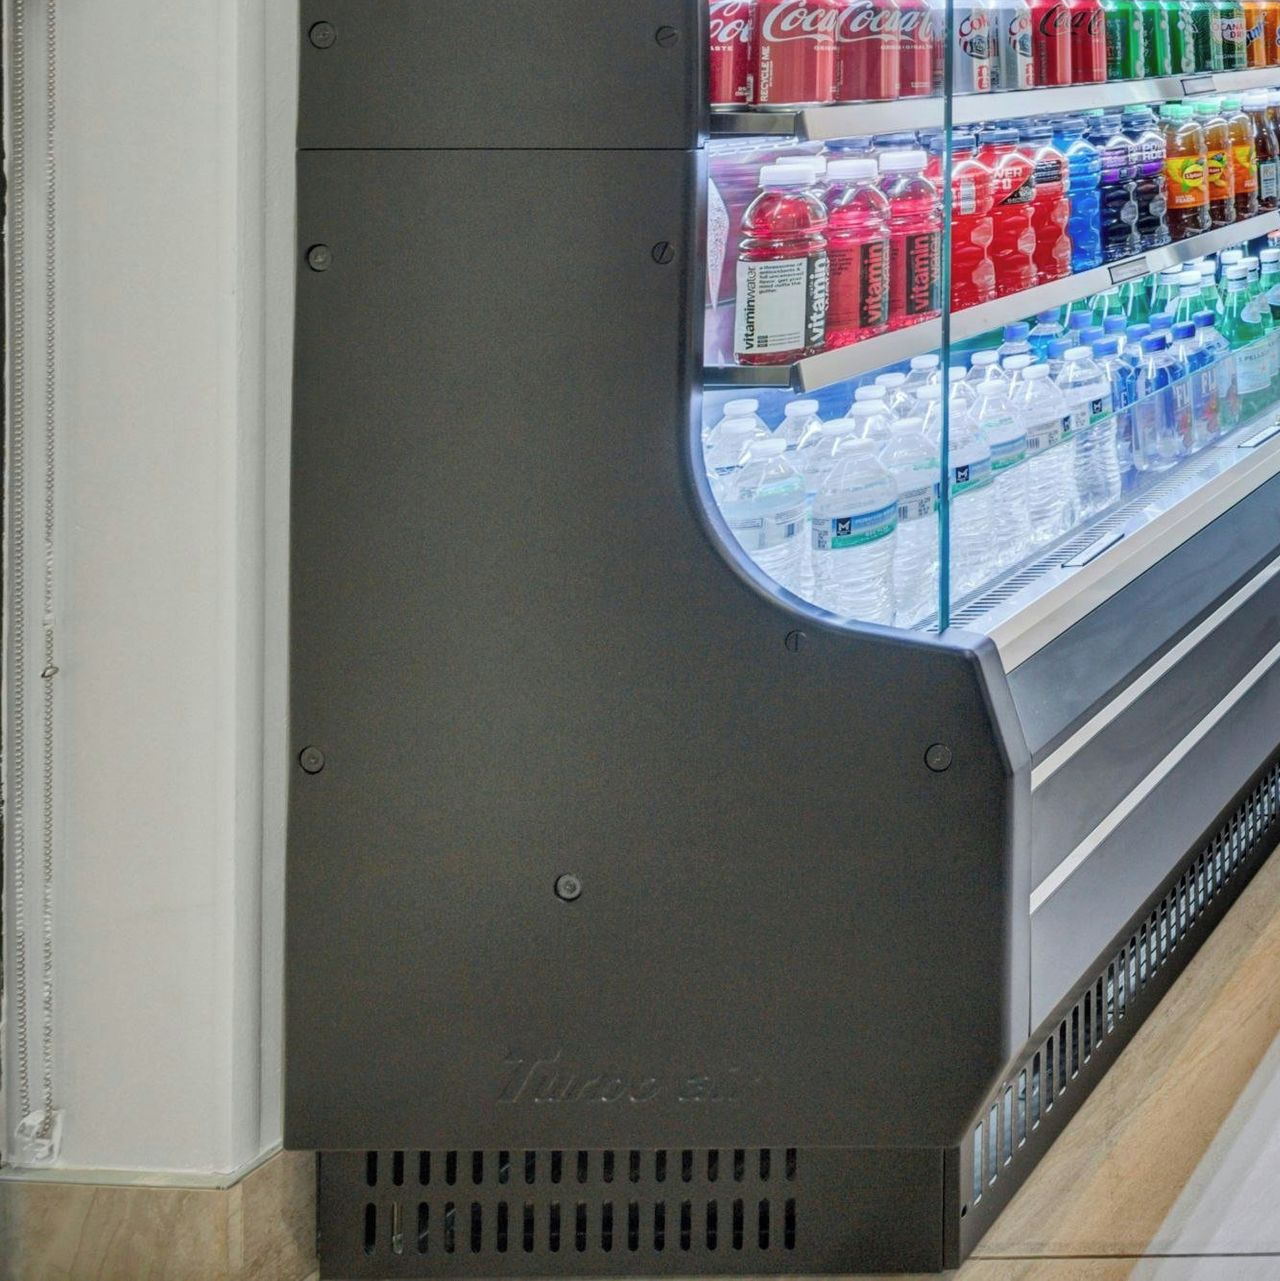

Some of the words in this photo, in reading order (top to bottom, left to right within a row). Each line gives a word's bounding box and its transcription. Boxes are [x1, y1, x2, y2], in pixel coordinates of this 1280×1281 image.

[760, 55, 770, 102] RECYCLE
[868, 241, 883, 325] vitamin
[915, 234, 930, 311] vitamin
